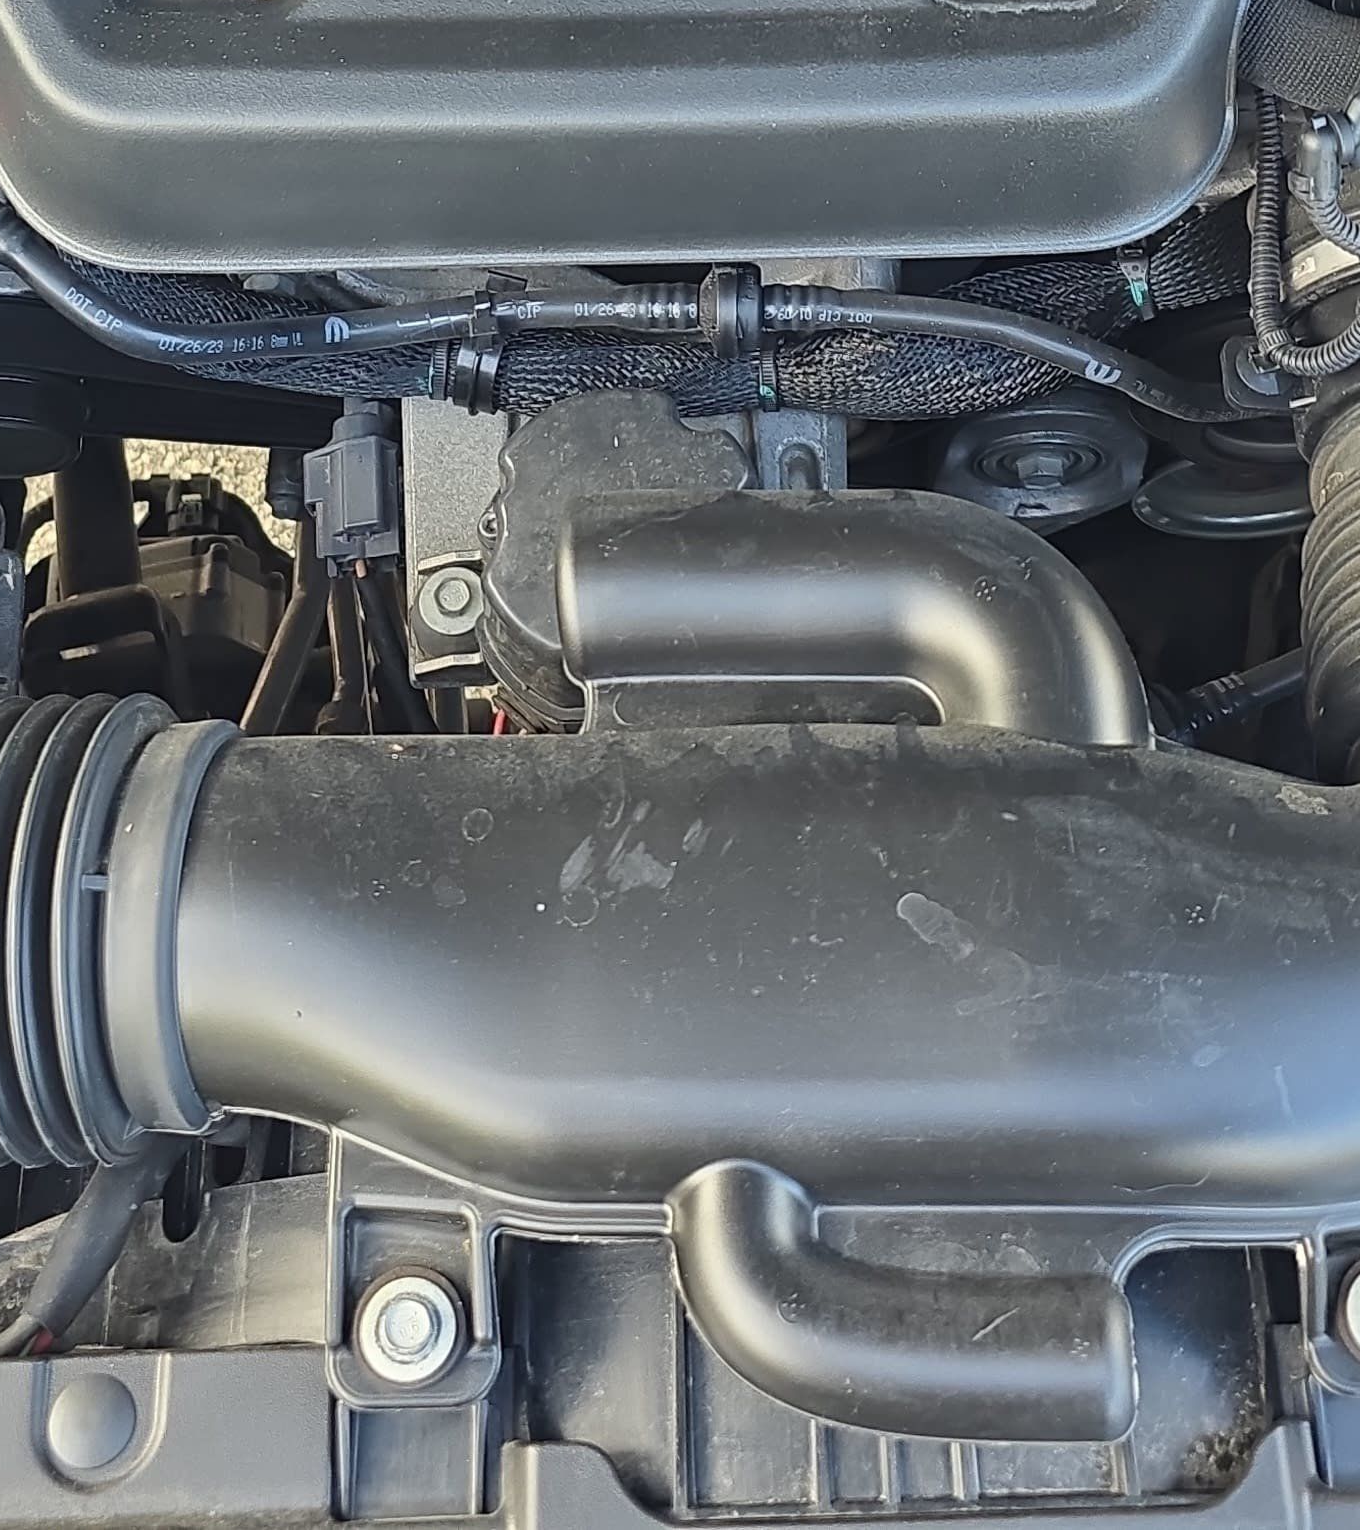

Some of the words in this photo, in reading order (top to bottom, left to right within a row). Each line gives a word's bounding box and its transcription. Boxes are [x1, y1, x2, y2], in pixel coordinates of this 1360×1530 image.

[517, 301, 542, 319] CIP
[818, 308, 841, 322] CIP
[846, 312, 872, 324] DOT
[63, 286, 93, 311] DOT
[93, 308, 124, 332] CIP
[157, 335, 224, 354] 01/26/23
[232, 335, 264, 353] 16:16
